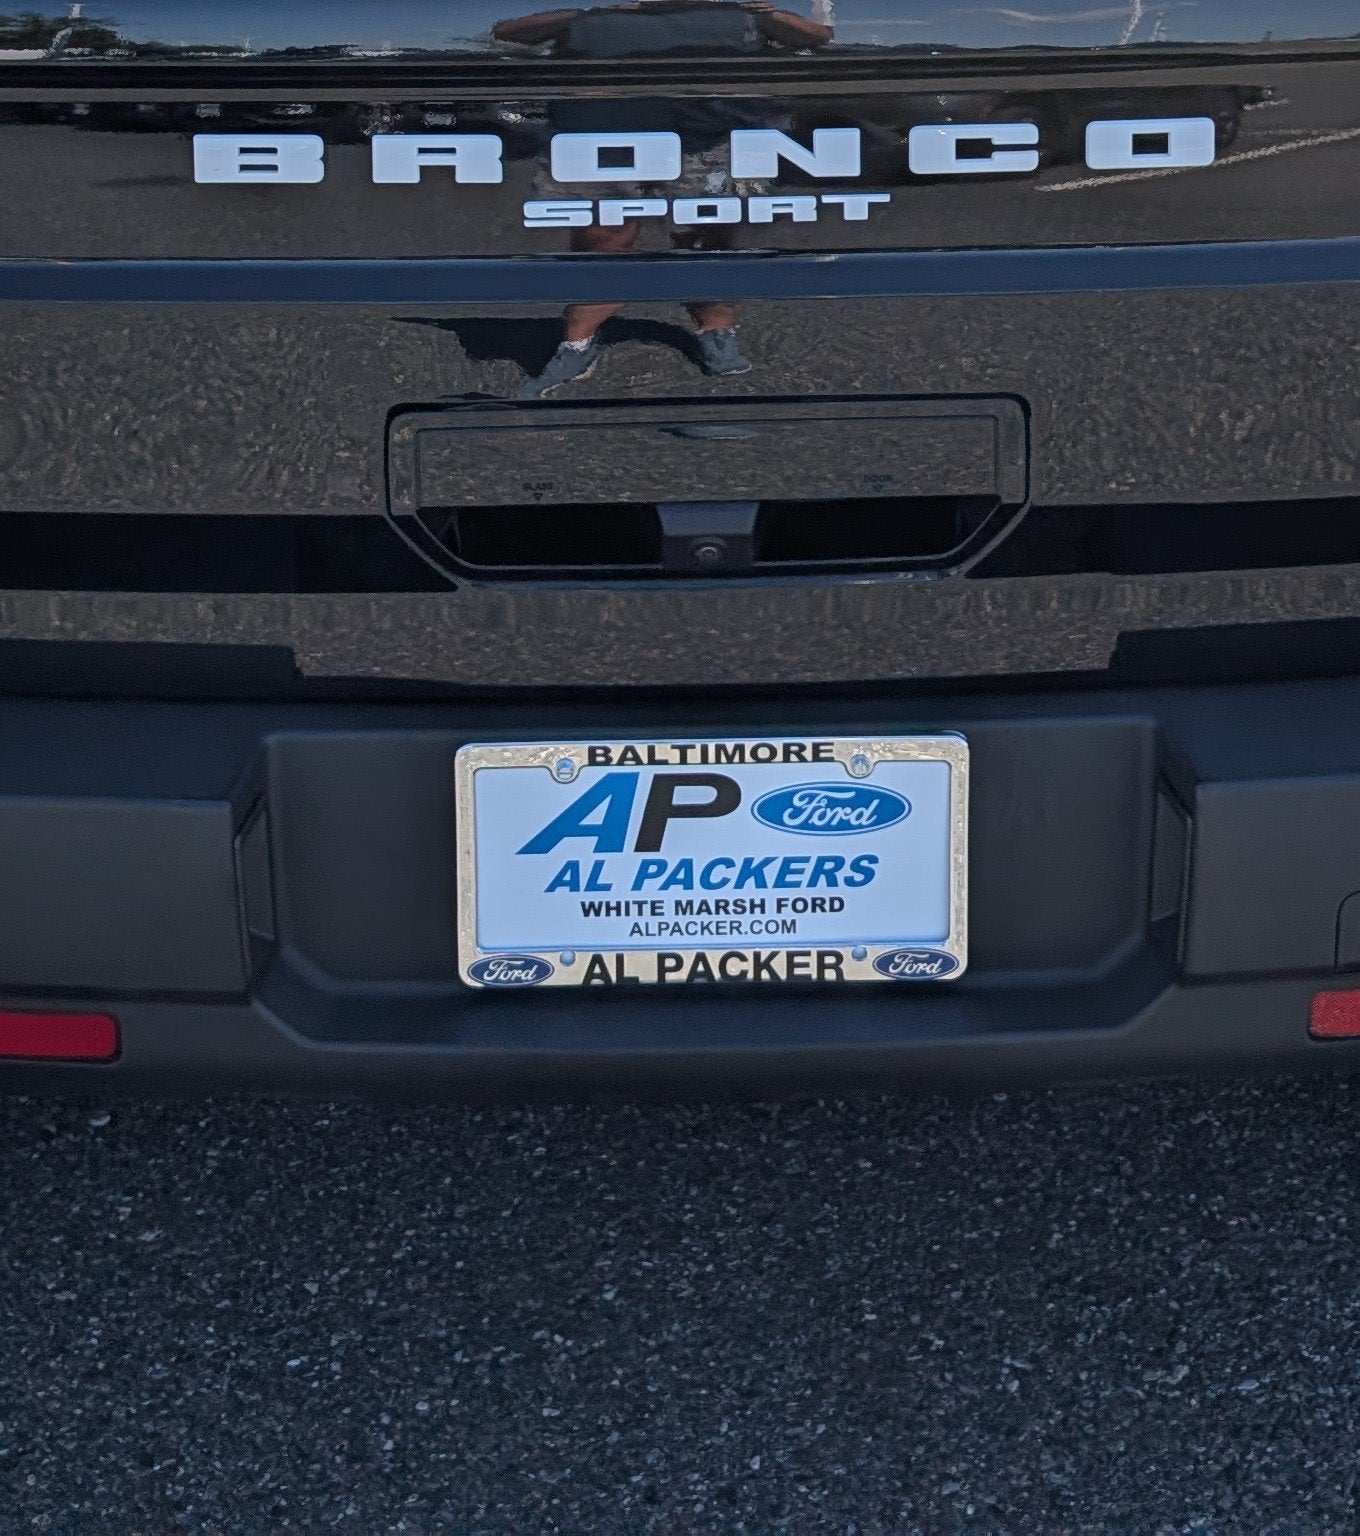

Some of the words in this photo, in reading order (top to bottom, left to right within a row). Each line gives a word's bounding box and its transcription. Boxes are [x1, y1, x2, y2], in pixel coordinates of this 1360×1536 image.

[193, 116, 1218, 185] BRONCO
[522, 193, 892, 228] SPORT
[587, 742, 835, 765] BALTIMORE
[515, 772, 742, 855] AP
[782, 790, 877, 827] Ford
[545, 858, 612, 893] AL
[631, 854, 879, 891] PACKERS
[580, 899, 665, 918] WHITE
[674, 898, 767, 916] MARSH
[775, 896, 846, 914] FORD
[629, 918, 798, 938] ALPACKER.COM
[483, 960, 539, 981] Ford
[581, 953, 640, 985] AL
[658, 950, 845, 983] PACKER
[888, 952, 944, 974] Ford
